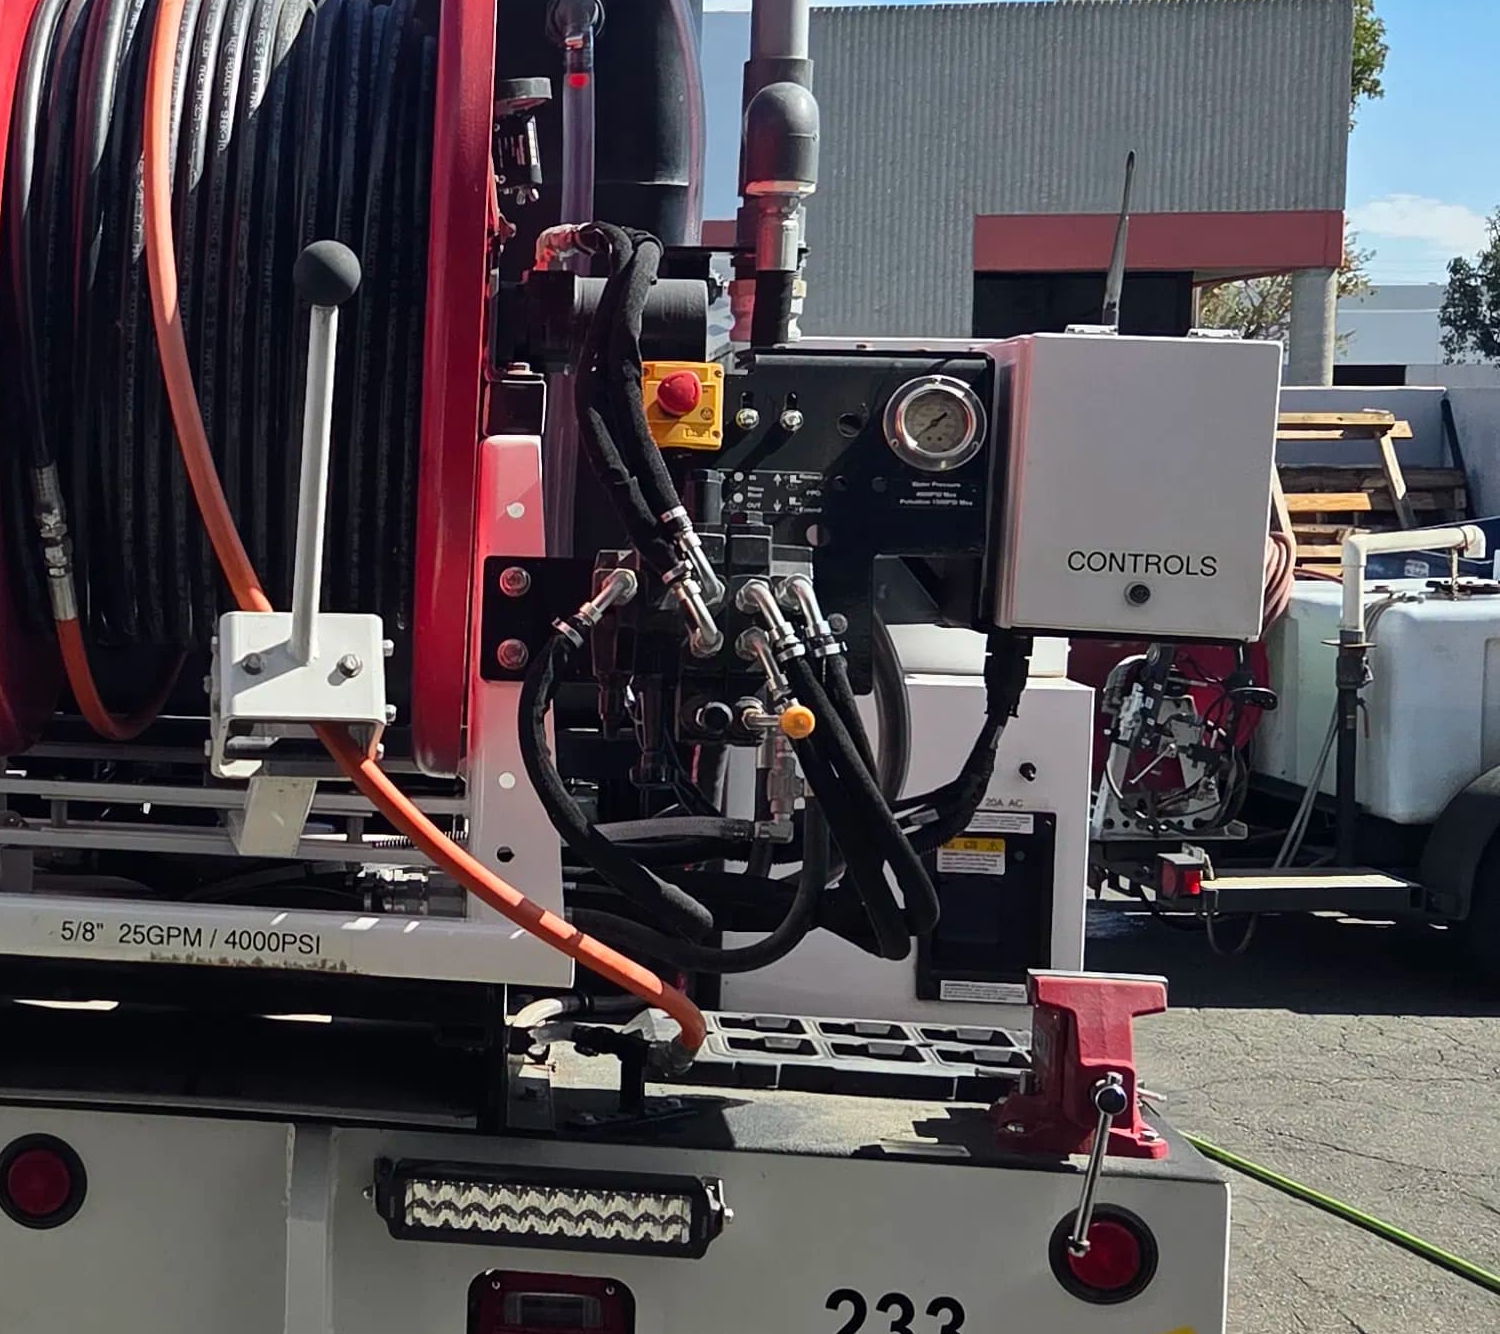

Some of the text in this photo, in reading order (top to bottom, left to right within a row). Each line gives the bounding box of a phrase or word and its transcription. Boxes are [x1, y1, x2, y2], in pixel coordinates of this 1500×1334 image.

[1068, 551, 1217, 577] CONTROLS
[61, 921, 104, 942] 5/8"
[118, 923, 202, 948] 25GPM
[224, 930, 320, 955] 4000PSI
